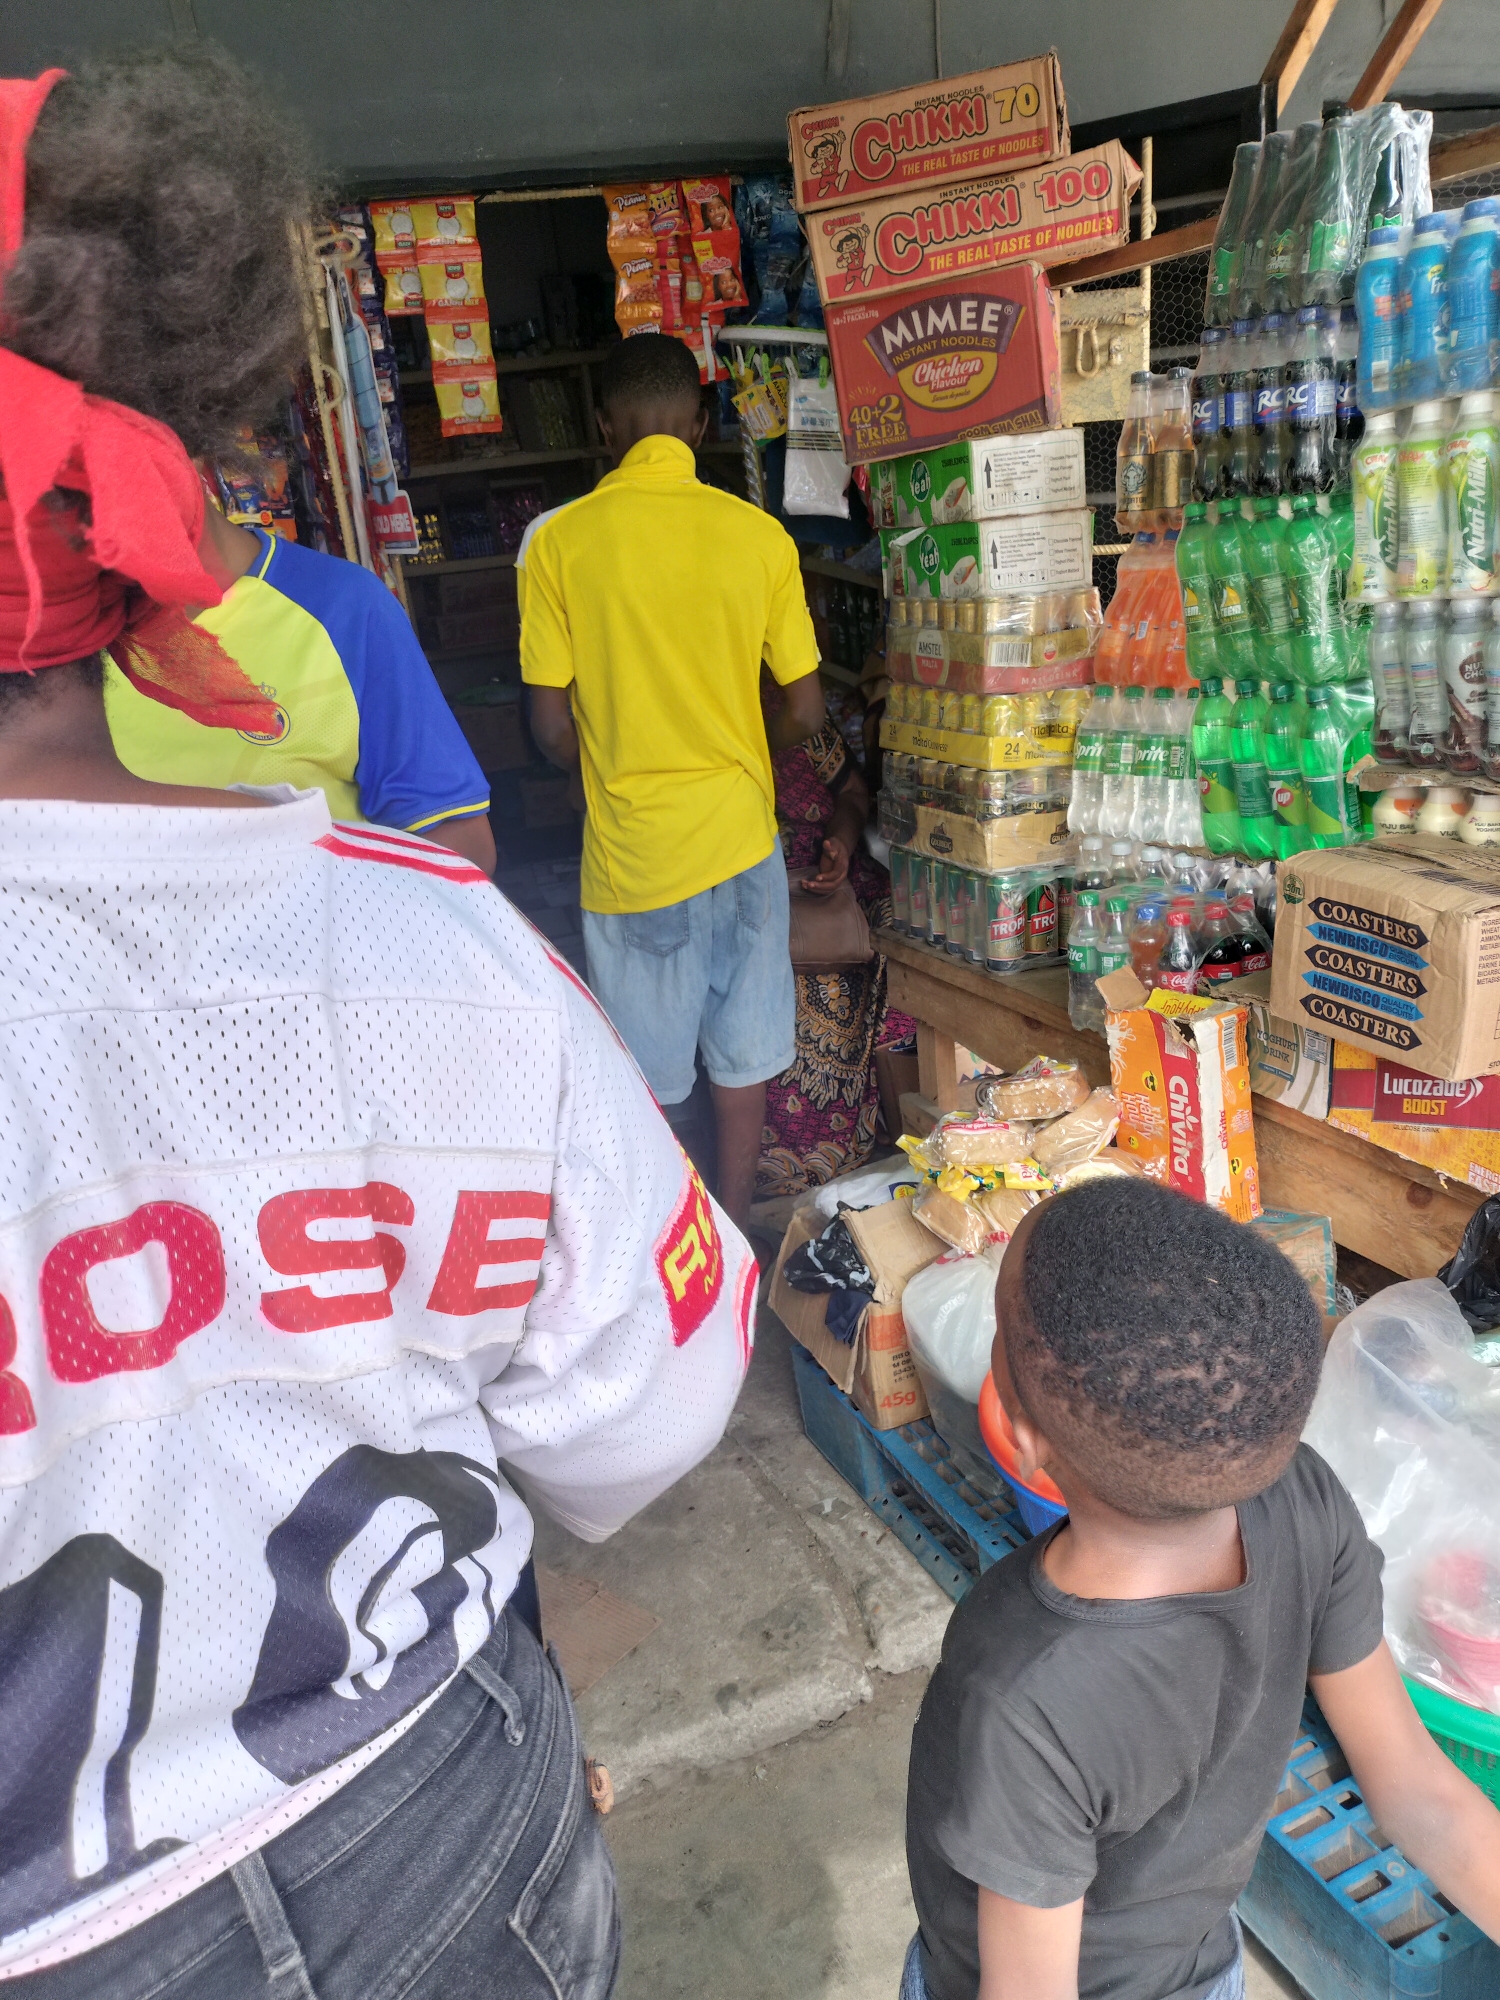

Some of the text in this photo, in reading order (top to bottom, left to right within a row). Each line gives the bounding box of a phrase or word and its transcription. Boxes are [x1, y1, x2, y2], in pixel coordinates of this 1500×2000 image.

[914, 85, 984, 107] INSTANT NOODLES
[801, 116, 840, 139] CHIKKI
[851, 83, 1040, 181] CHIKKI 70
[902, 134, 1044, 176] THE REAL TASTE OF NOODLES
[939, 175, 1016, 199] INSTANT NOODLES
[822, 213, 861, 236] CHIKKI
[874, 160, 1112, 276] CHIKKI 100
[929, 214, 1114, 272] THE REAL TASTE OF NOODLES
[881, 300, 1001, 355] MIMEE
[893, 335, 996, 366] INSTANT NOODLES
[914, 356, 981, 386] Chicken
[931, 375, 968, 390] Flavour
[1257, 388, 1284, 413] RC
[1286, 384, 1308, 407] RC
[856, 421, 906, 443] FREE
[992, 420, 1013, 434] SHA
[910, 473, 931, 497] Yeah
[919, 548, 940, 570] Yeah
[918, 641, 942, 656] AMSTEL
[921, 659, 938, 669] MALTA
[1004, 743, 1020, 756] 24
[1318, 901, 1418, 945] COASTERS
[1317, 925, 1389, 958] NEWBISCO
[1314, 949, 1418, 994] COASTERS
[1312, 973, 1416, 1013] NEWBISCO QUALITY
[1309, 997, 1411, 1047] COASTERS
[1380, 1004, 1414, 1020] BISCUITS
[1257, 1029, 1298, 1051] YOGHURT
[1263, 1045, 1290, 1063] DRINK
[1383, 1073, 1468, 1098] Lucozade
[1135, 1091, 1156, 1140] Happy
[1403, 1098, 1448, 1116] BOOST
[1168, 1075, 1200, 1176] Chivita
[1219, 1109, 1228, 1150] Chivita
[1393, 1124, 1440, 1134] GLUCOSE DRINK
[880, 1390, 916, 1409] 45g
